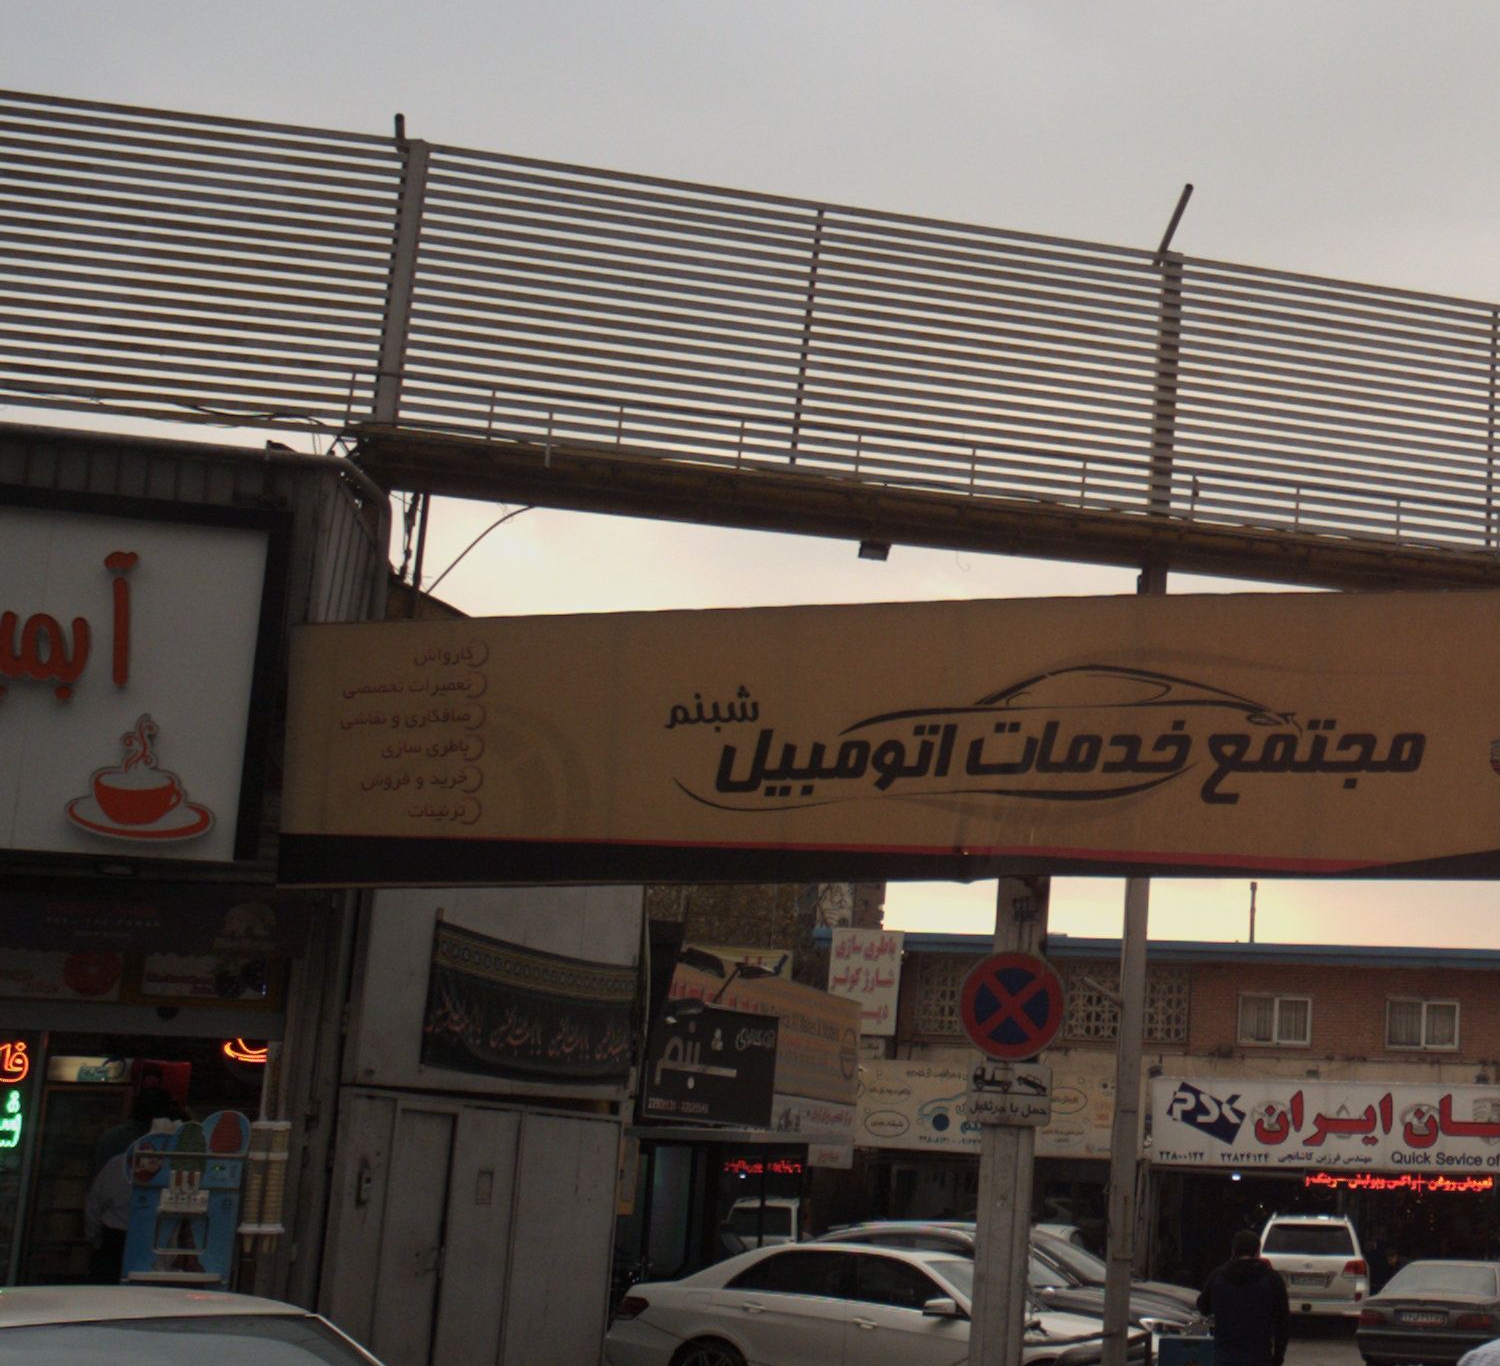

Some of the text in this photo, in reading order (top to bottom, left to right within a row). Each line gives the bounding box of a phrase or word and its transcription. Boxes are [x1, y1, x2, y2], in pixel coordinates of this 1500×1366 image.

[664, 684, 761, 731] شبنم
[715, 714, 1426, 805] مجتمع خدمات اتومبیل
[1008, 1101, 1019, 1116] با
[1021, 1103, 1048, 1119] حمل
[1253, 1090, 1394, 1148] ایران
[1391, 1151, 1431, 1165] Quick
[1435, 1152, 1483, 1166] Sevice
[1486, 1153, 1500, 1167] of
